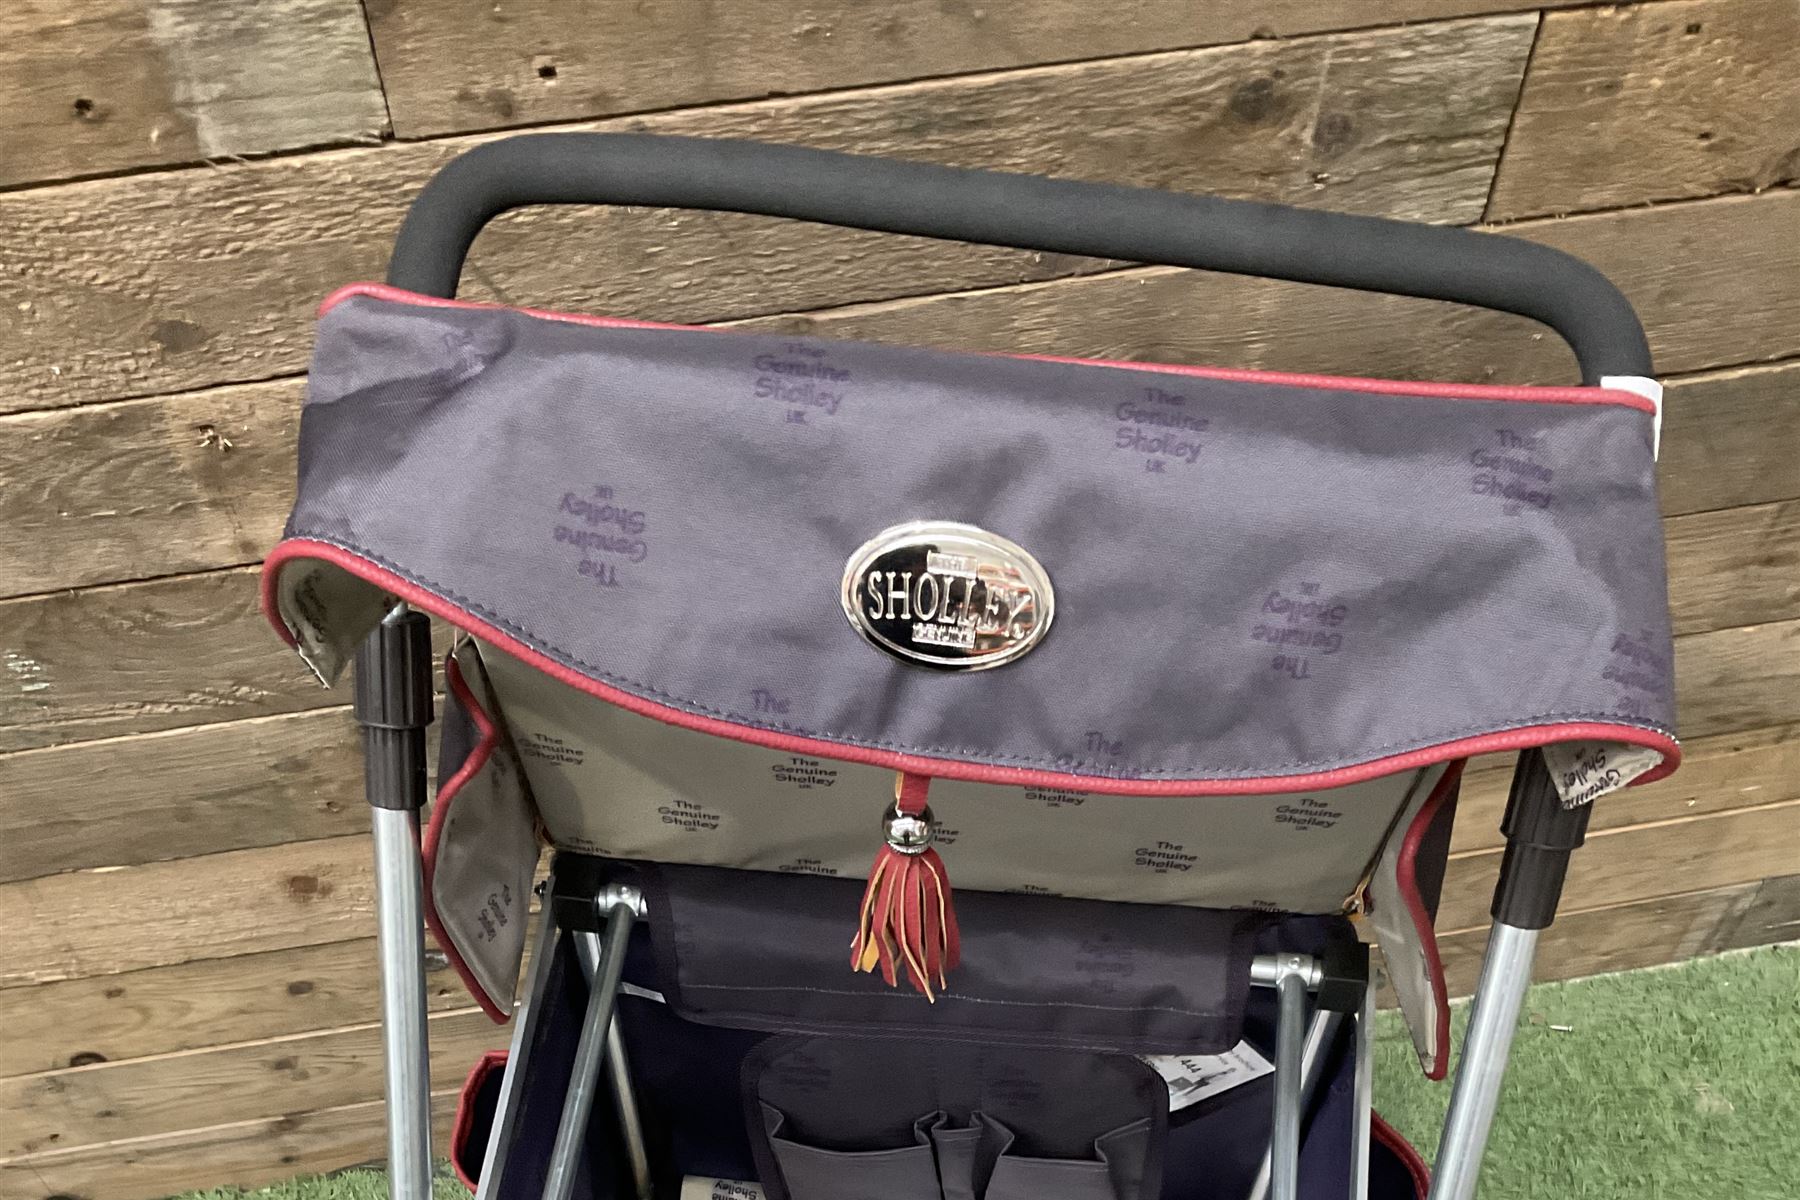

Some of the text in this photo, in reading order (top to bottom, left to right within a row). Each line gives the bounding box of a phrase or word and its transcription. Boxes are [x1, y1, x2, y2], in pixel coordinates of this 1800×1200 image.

[753, 378, 845, 415] Sholley
[1117, 402, 1208, 432] Genuine
[1115, 427, 1202, 464] Sholley
[558, 492, 645, 534] Sholley
[553, 525, 648, 563] Genuine
[867, 570, 1033, 639] SHOLLEY
[533, 733, 562, 744] The
[790, 757, 819, 767] The
[772, 764, 838, 777] Genuine
[775, 773, 836, 787] Sholley
[673, 800, 702, 811] The
[1025, 792, 1085, 806] Sholley
[1301, 799, 1329, 808] The
[658, 806, 720, 821] Genuine
[1276, 805, 1343, 818] Genuine
[662, 816, 719, 830] Sholley
[1274, 814, 1338, 828] Sholley
[1156, 841, 1184, 851] The
[1135, 848, 1198, 862] Genuine
[1134, 857, 1193, 871] Sholley
[715, 1181, 758, 1200] Sholley
